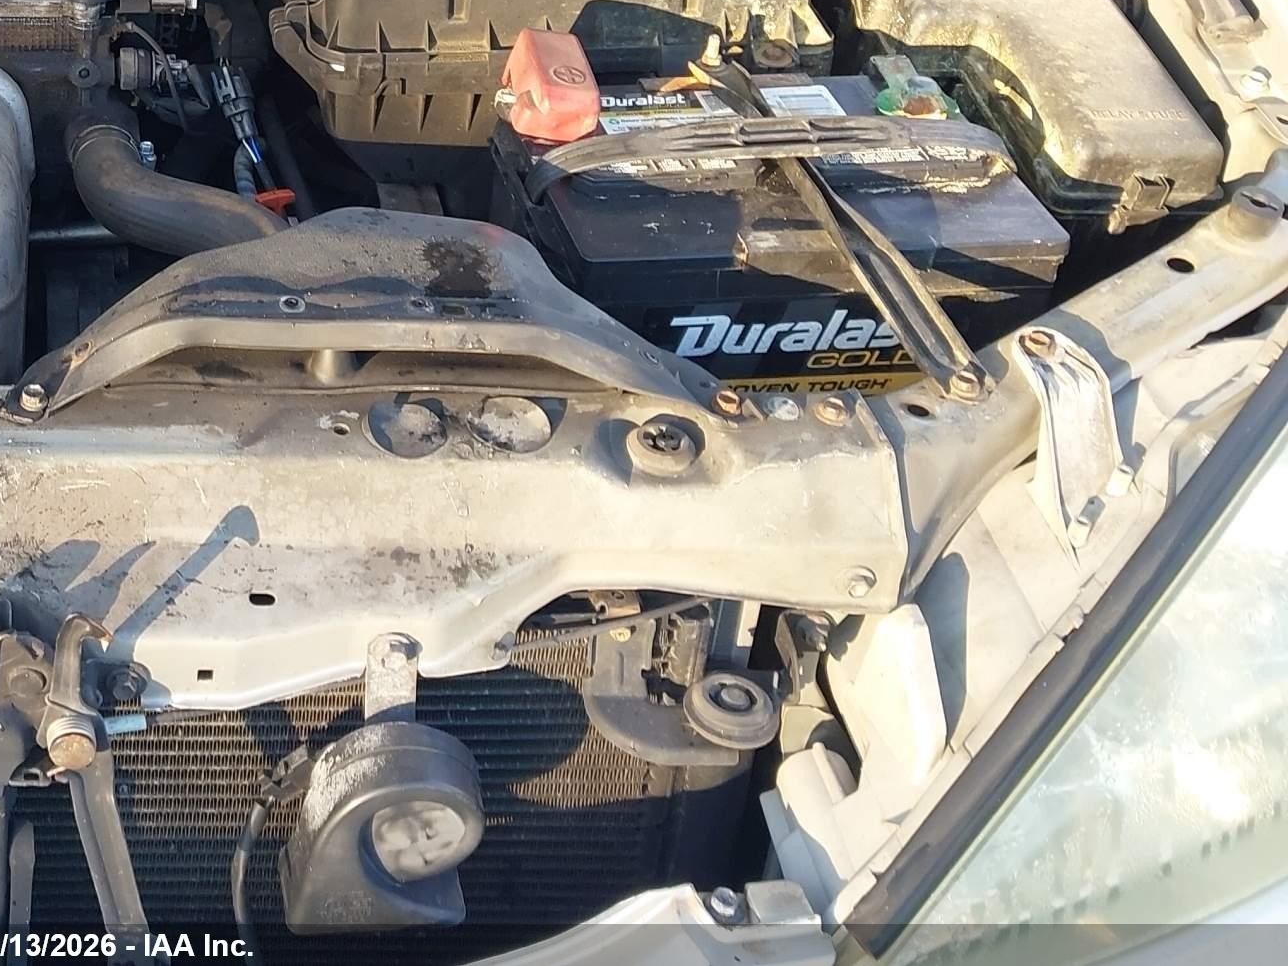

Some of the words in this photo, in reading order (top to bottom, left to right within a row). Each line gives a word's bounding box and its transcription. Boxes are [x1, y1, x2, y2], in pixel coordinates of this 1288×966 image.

[600, 94, 686, 107] Duralast
[670, 309, 899, 358] Duralas
[728, 382, 801, 393] OVEN
